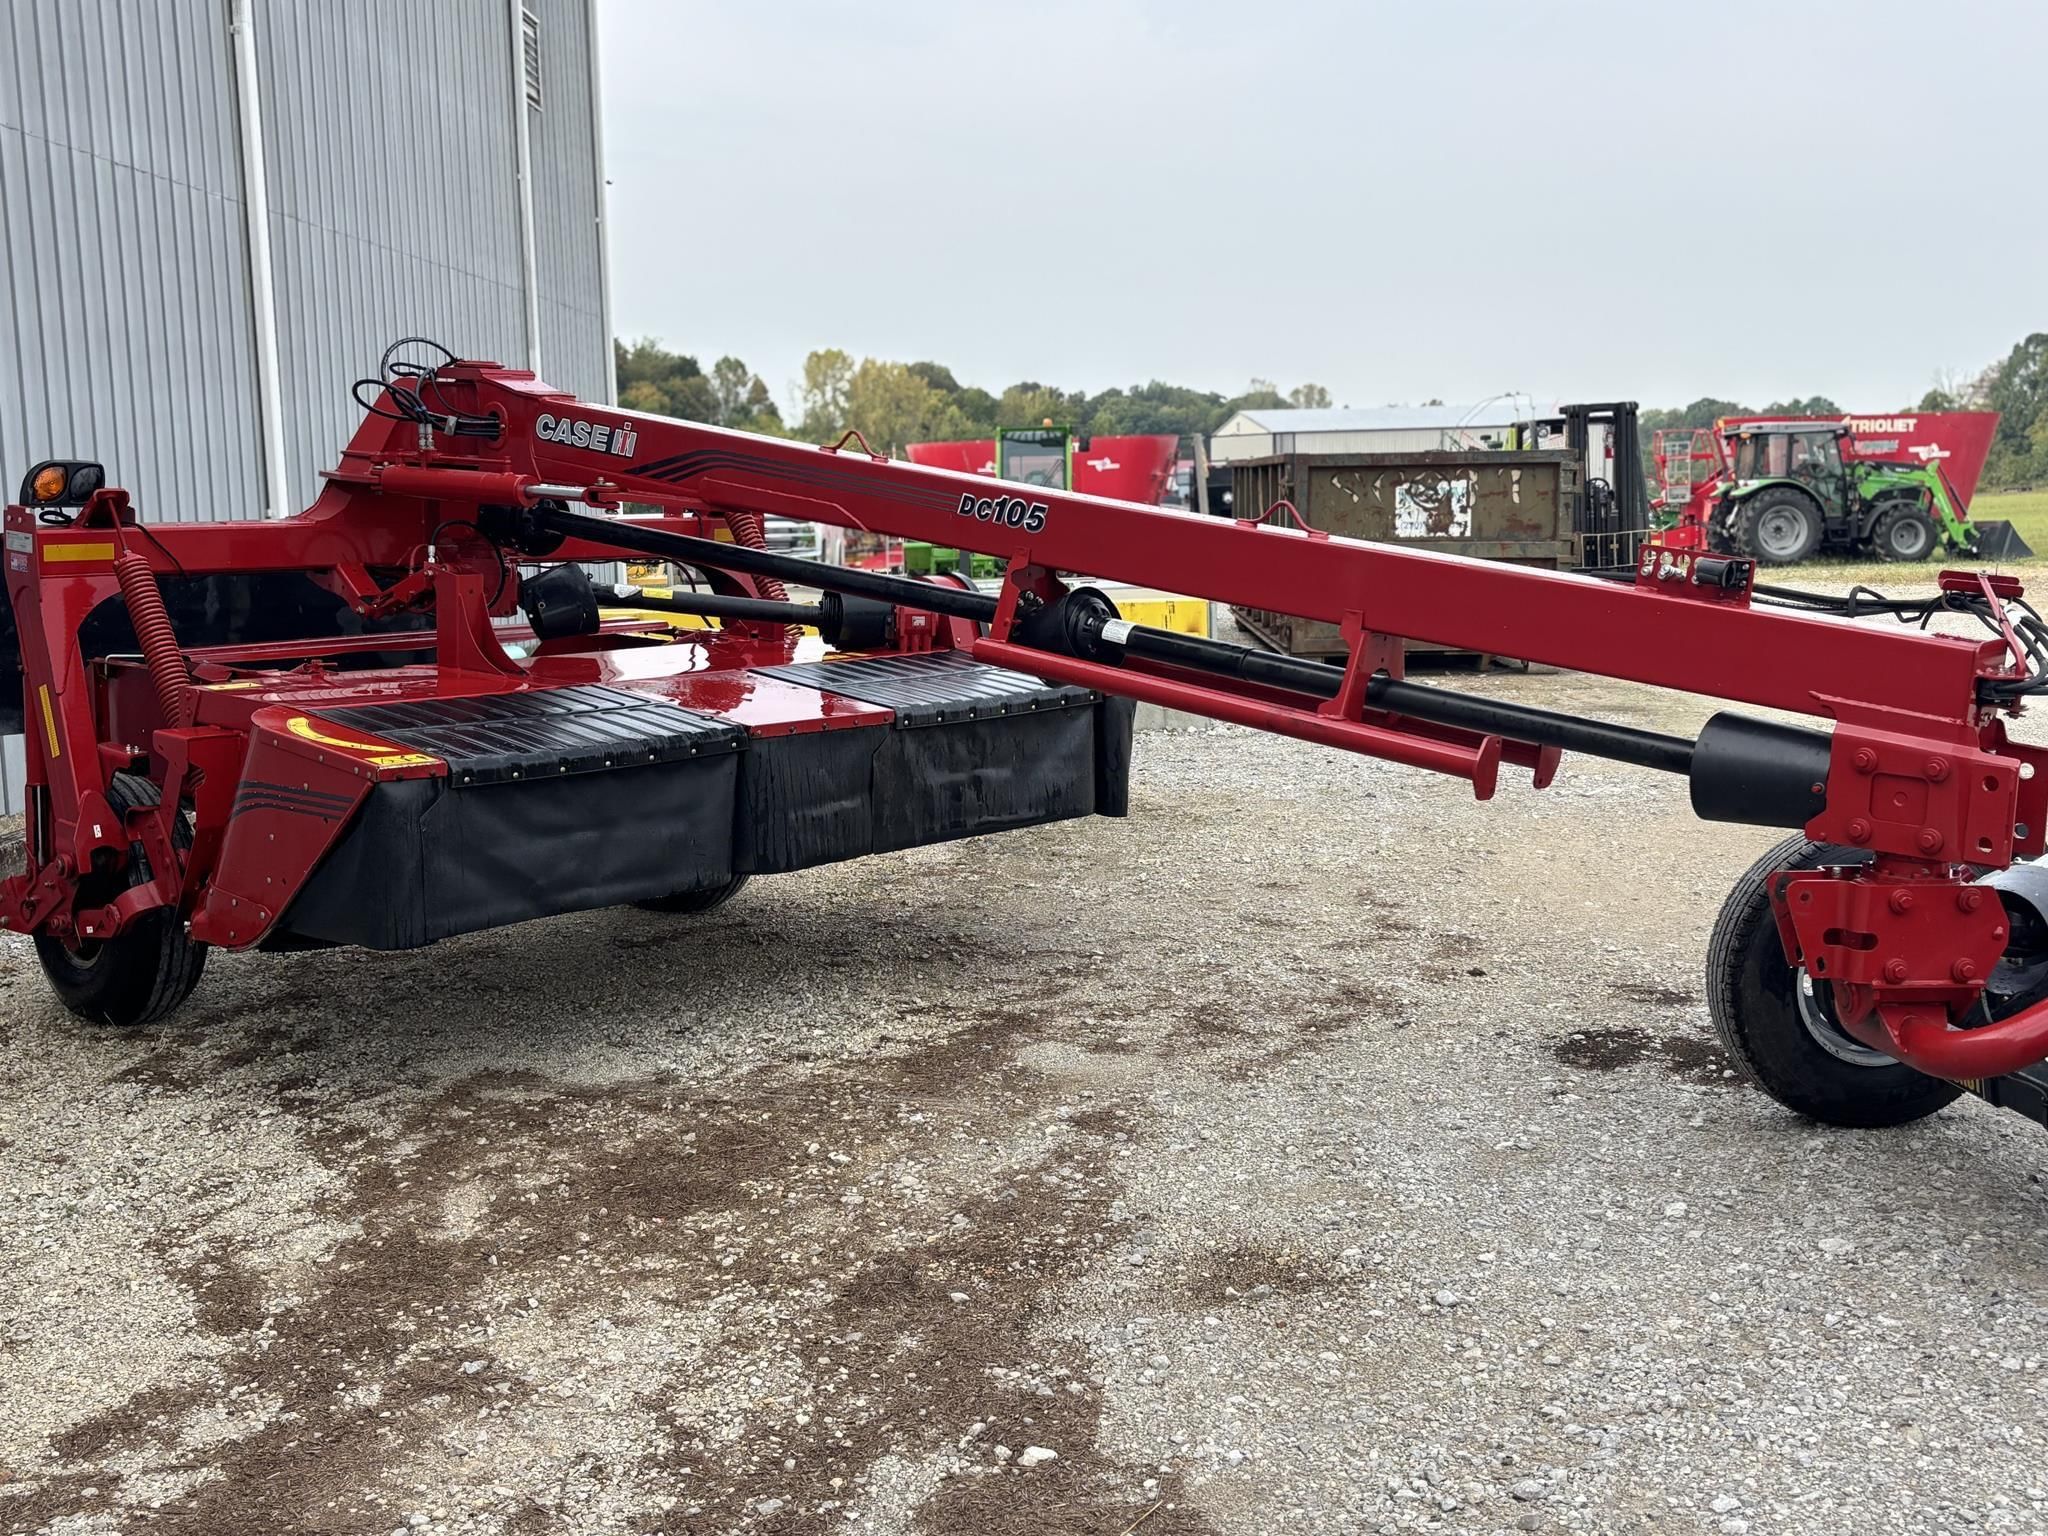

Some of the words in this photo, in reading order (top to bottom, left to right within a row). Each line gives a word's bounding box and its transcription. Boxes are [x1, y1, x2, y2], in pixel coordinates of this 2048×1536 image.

[535, 413, 610, 452] CASE
[1849, 418, 1918, 433] TRIOLIET
[957, 492, 1049, 534] DC105
